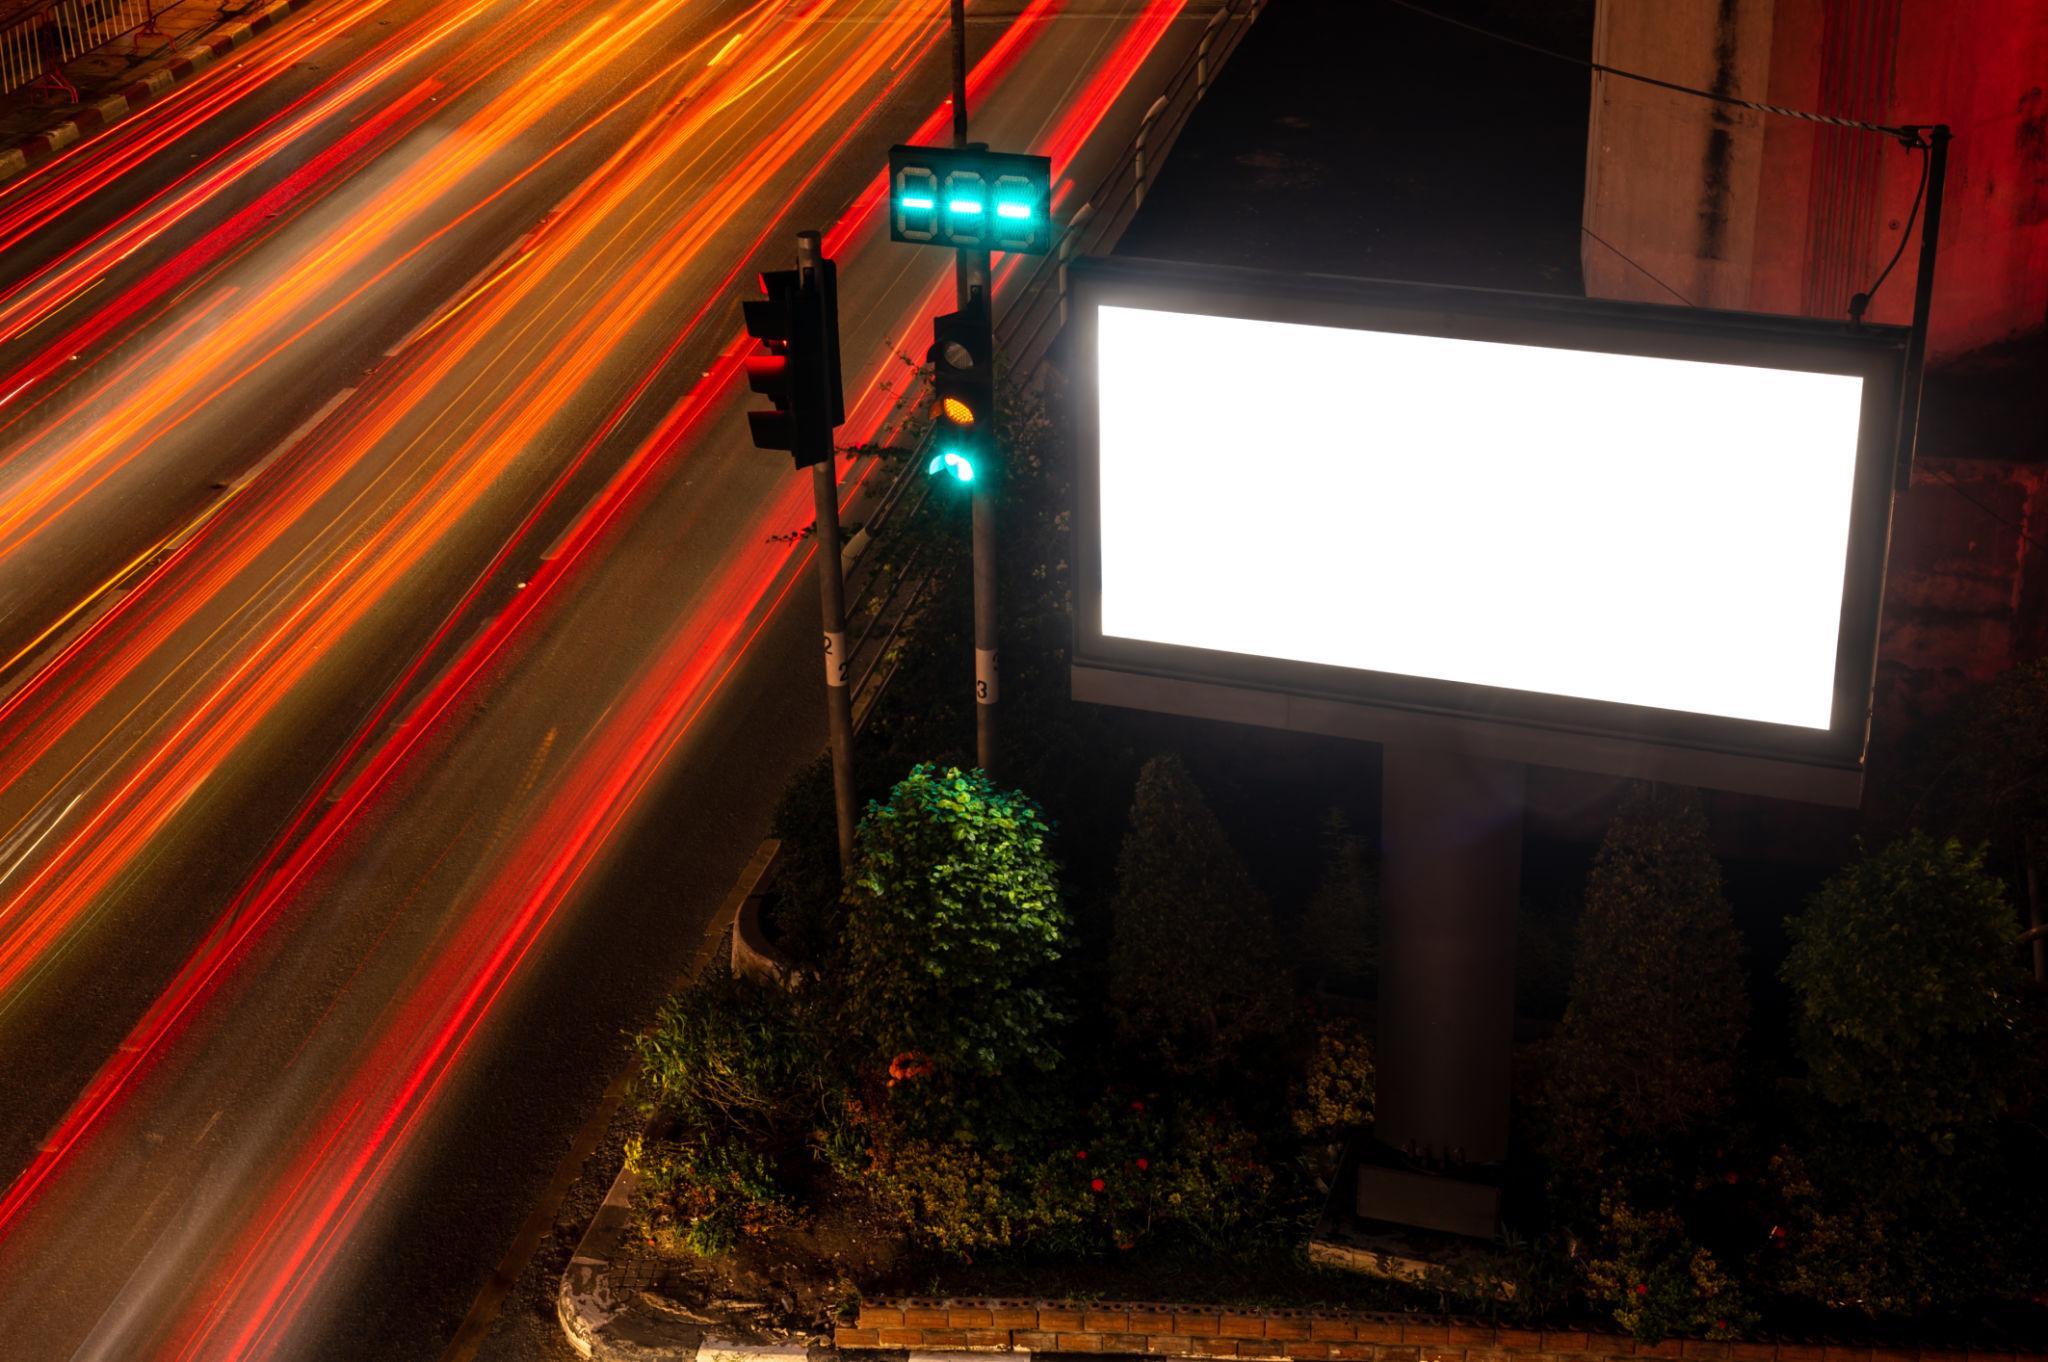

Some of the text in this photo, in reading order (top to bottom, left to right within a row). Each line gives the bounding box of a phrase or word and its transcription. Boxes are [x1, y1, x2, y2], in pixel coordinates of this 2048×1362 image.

[823, 636, 833, 655] 2
[838, 662, 849, 682] 2
[977, 680, 987, 699] 3
